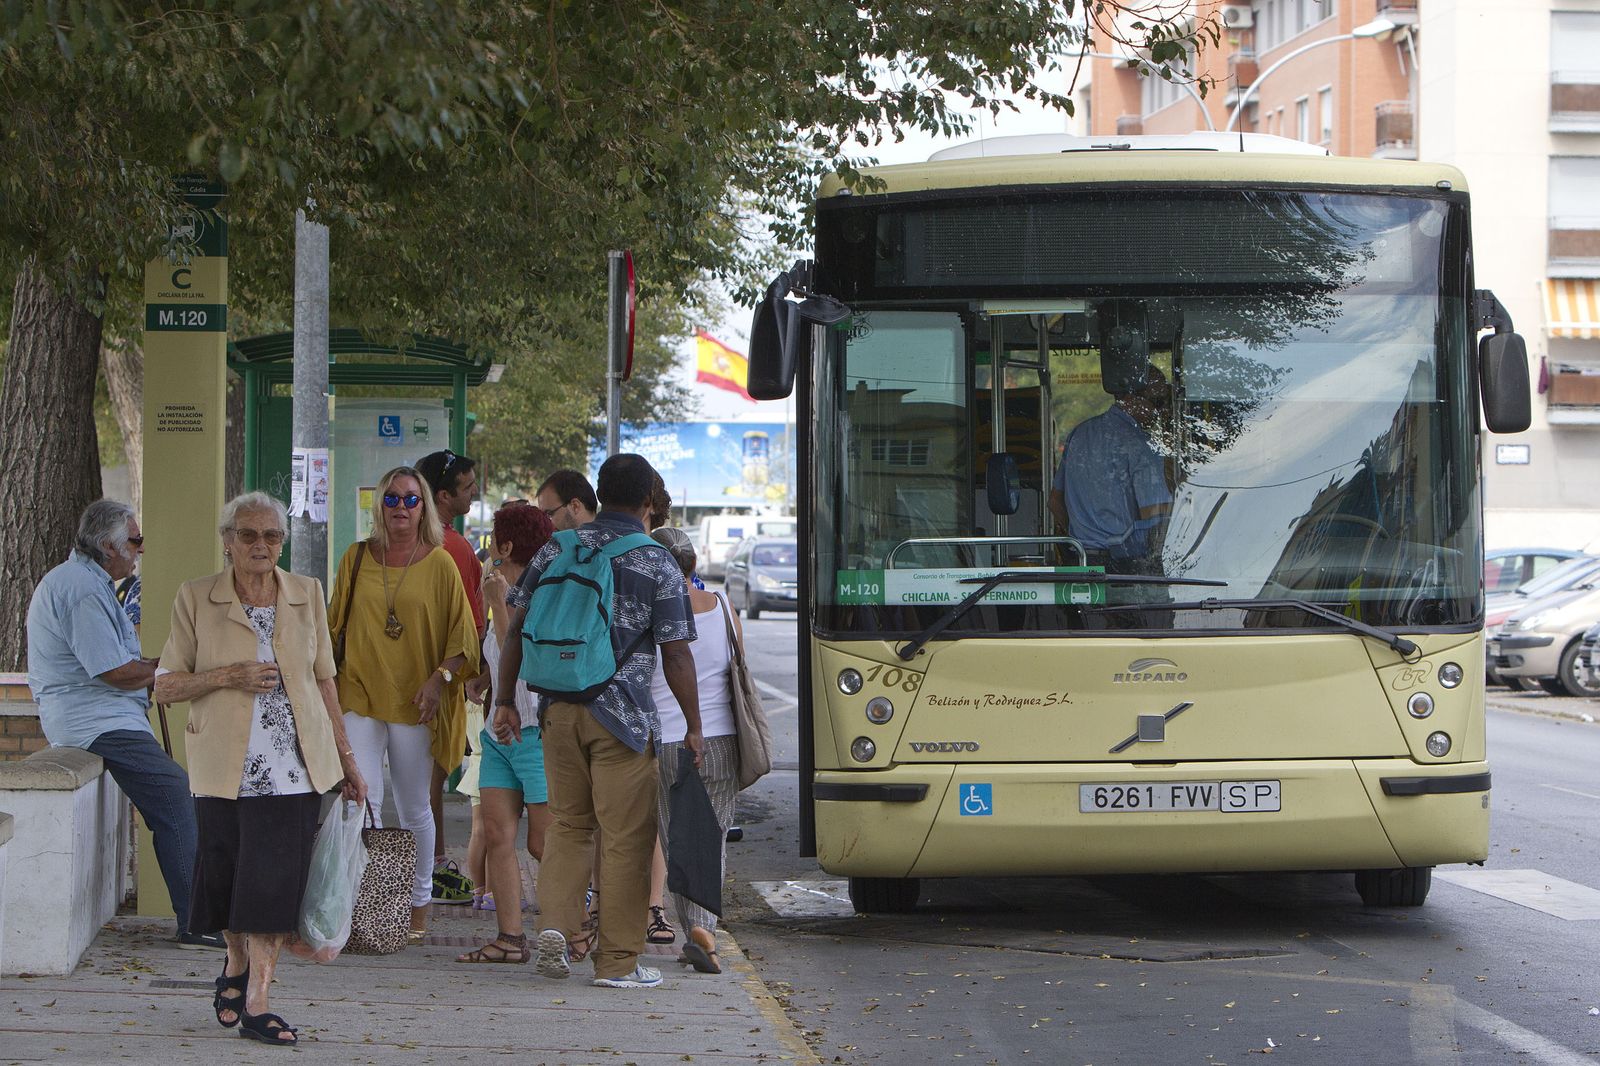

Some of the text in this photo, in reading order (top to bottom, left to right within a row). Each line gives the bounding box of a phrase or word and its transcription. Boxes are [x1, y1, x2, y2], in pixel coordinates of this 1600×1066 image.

[171, 268, 192, 290] C
[159, 309, 208, 327] M.120
[840, 583, 879, 596] M-120
[901, 592, 950, 602] CHICLANA
[984, 590, 1038, 601] FERNANDO
[866, 664, 922, 693] 108
[1113, 672, 1188, 684] HISPANO
[925, 694, 970, 706] Belizón
[973, 698, 981, 710] y
[1042, 692, 1074, 707] S.L.
[908, 741, 980, 753] VOLVO
[1094, 785, 1153, 809] 6261
[1171, 785, 1213, 808] FVV
